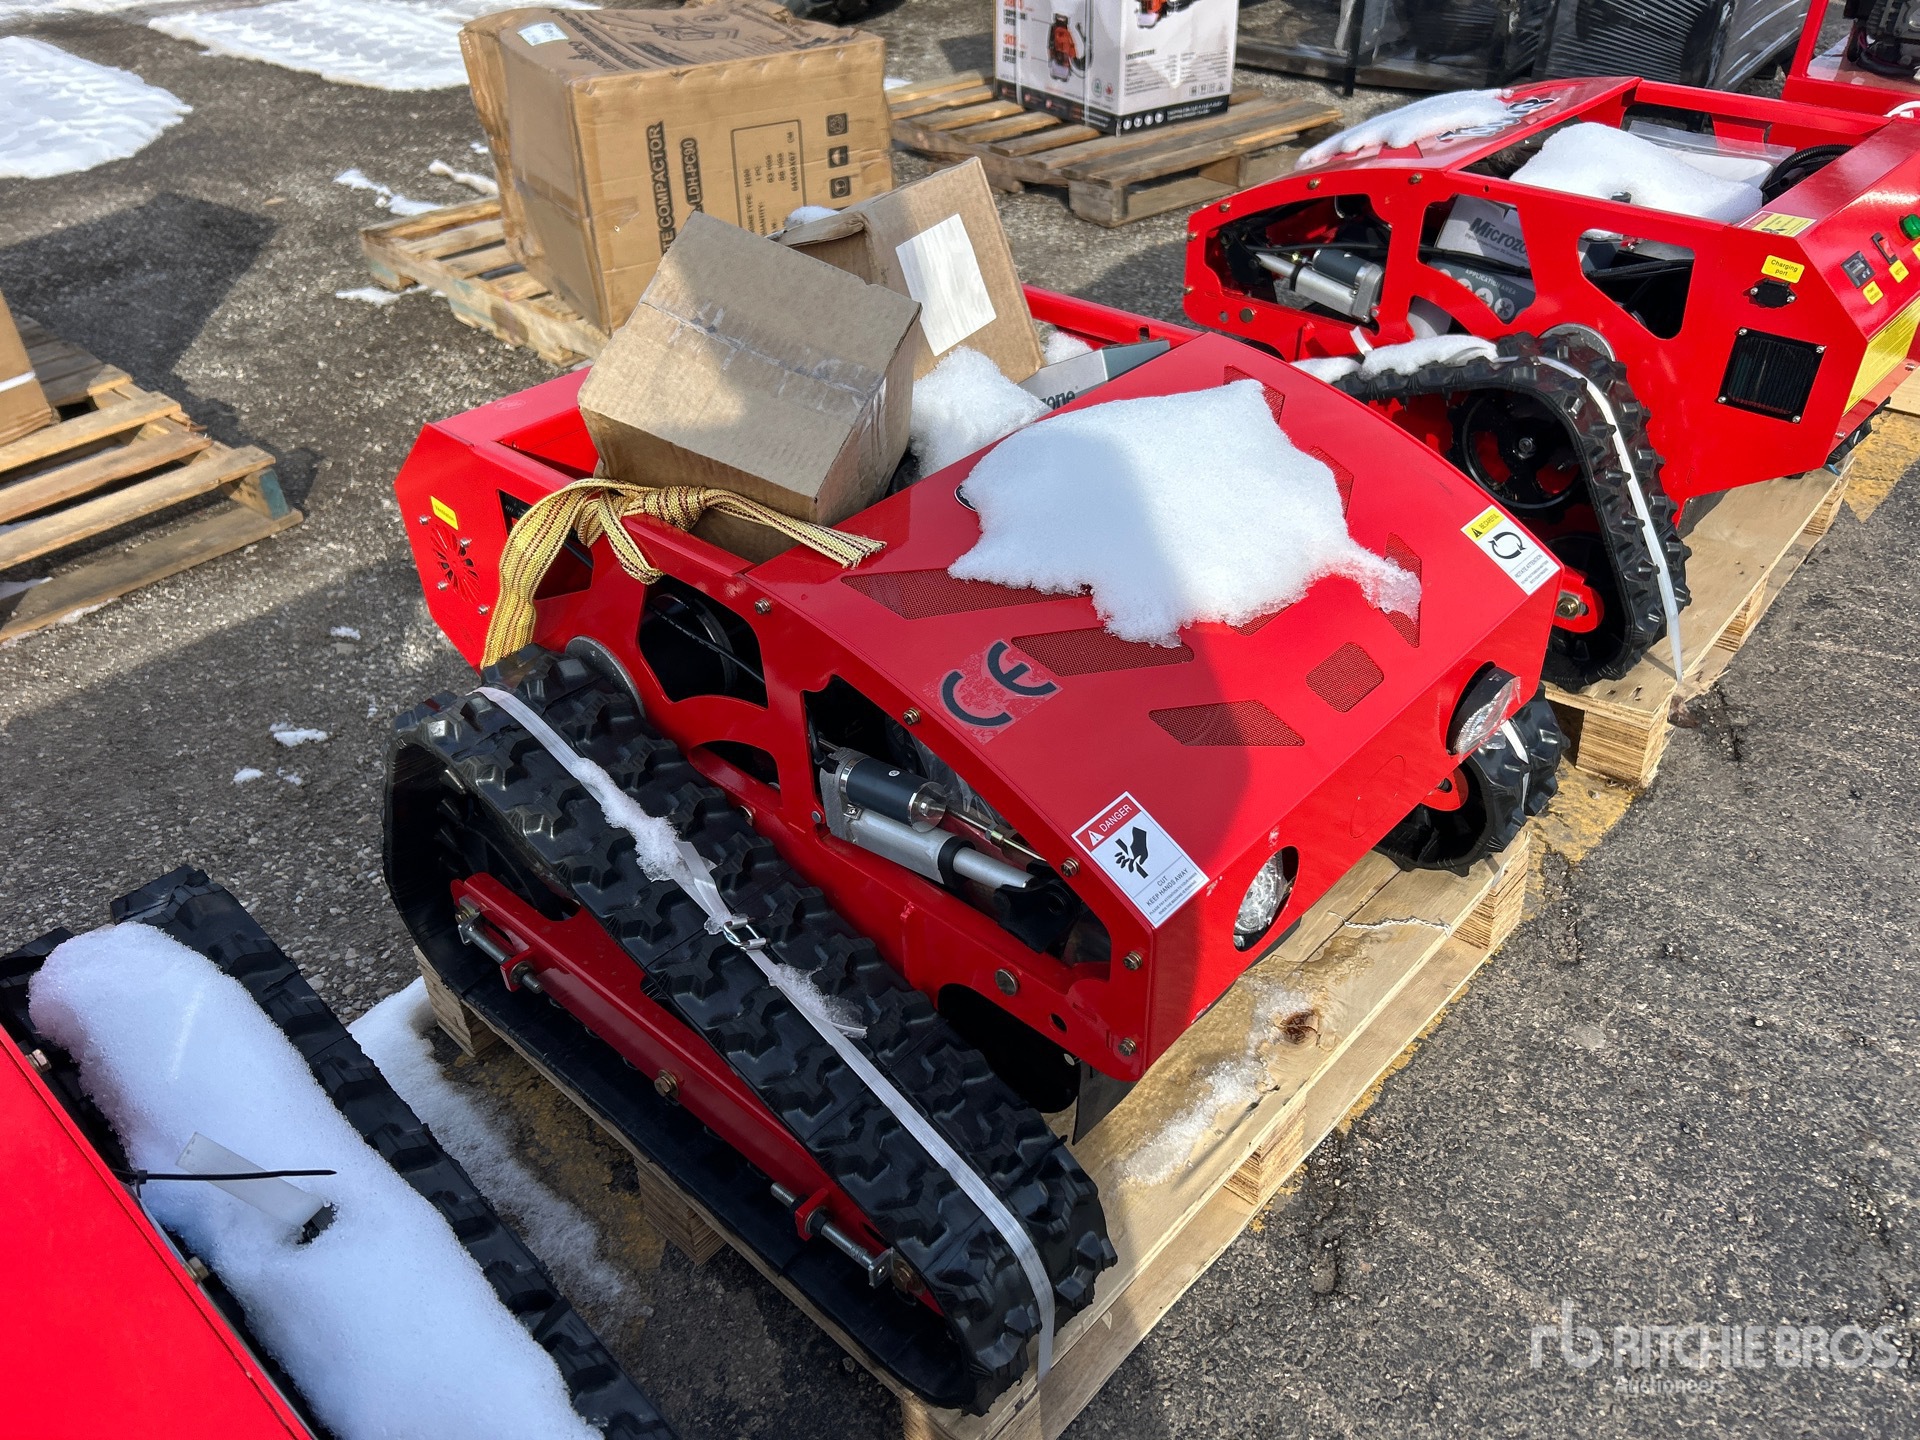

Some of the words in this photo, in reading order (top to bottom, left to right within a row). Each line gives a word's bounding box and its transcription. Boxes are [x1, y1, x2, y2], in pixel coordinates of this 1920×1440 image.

[648, 123, 673, 228] COMPACTOR
[682, 139, 702, 204] LDH-PC90
[1470, 217, 1528, 254] Microzo
[1771, 259, 1799, 273] Charging
[1775, 268, 1788, 276] port
[942, 640, 1058, 727] CE
[1099, 804, 1133, 832] DANGER
[1146, 893, 1160, 906] KEEP
[1159, 880, 1176, 896] HANDS
[1175, 868, 1189, 882] AWAY
[1157, 875, 1168, 887] CUT
